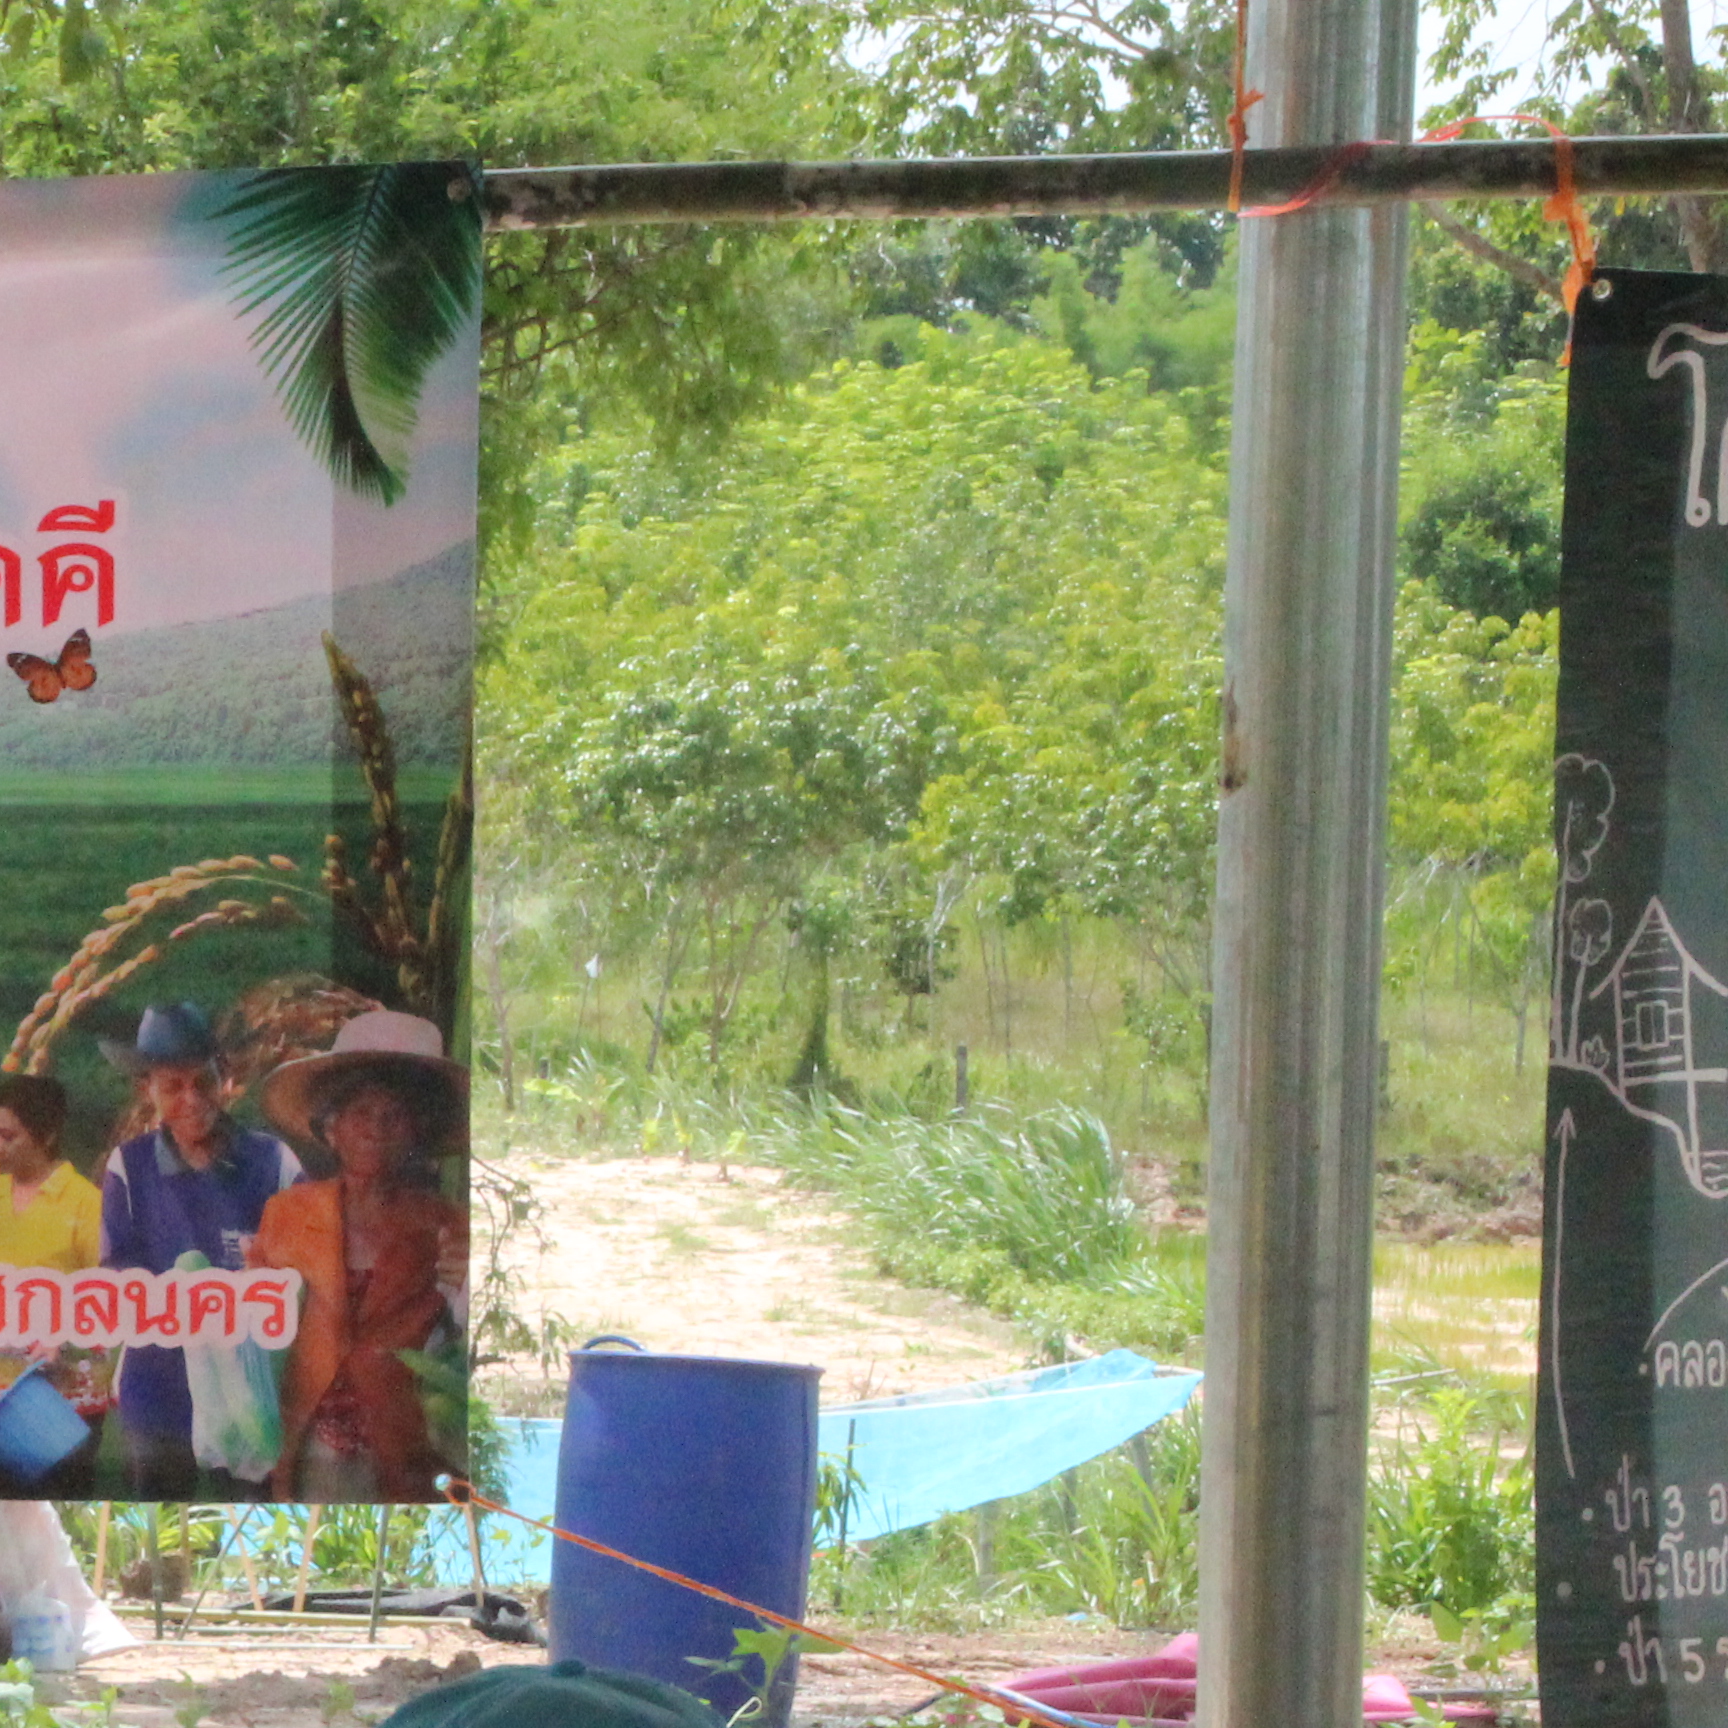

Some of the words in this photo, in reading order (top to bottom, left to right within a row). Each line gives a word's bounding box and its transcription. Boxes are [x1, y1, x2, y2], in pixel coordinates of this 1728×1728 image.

[1654, 1339, 1728, 1388] คลอ
[1662, 1484, 1686, 1529] 3
[1613, 1530, 1728, 1602] ประโยช
[1679, 1637, 1706, 1683] 5
